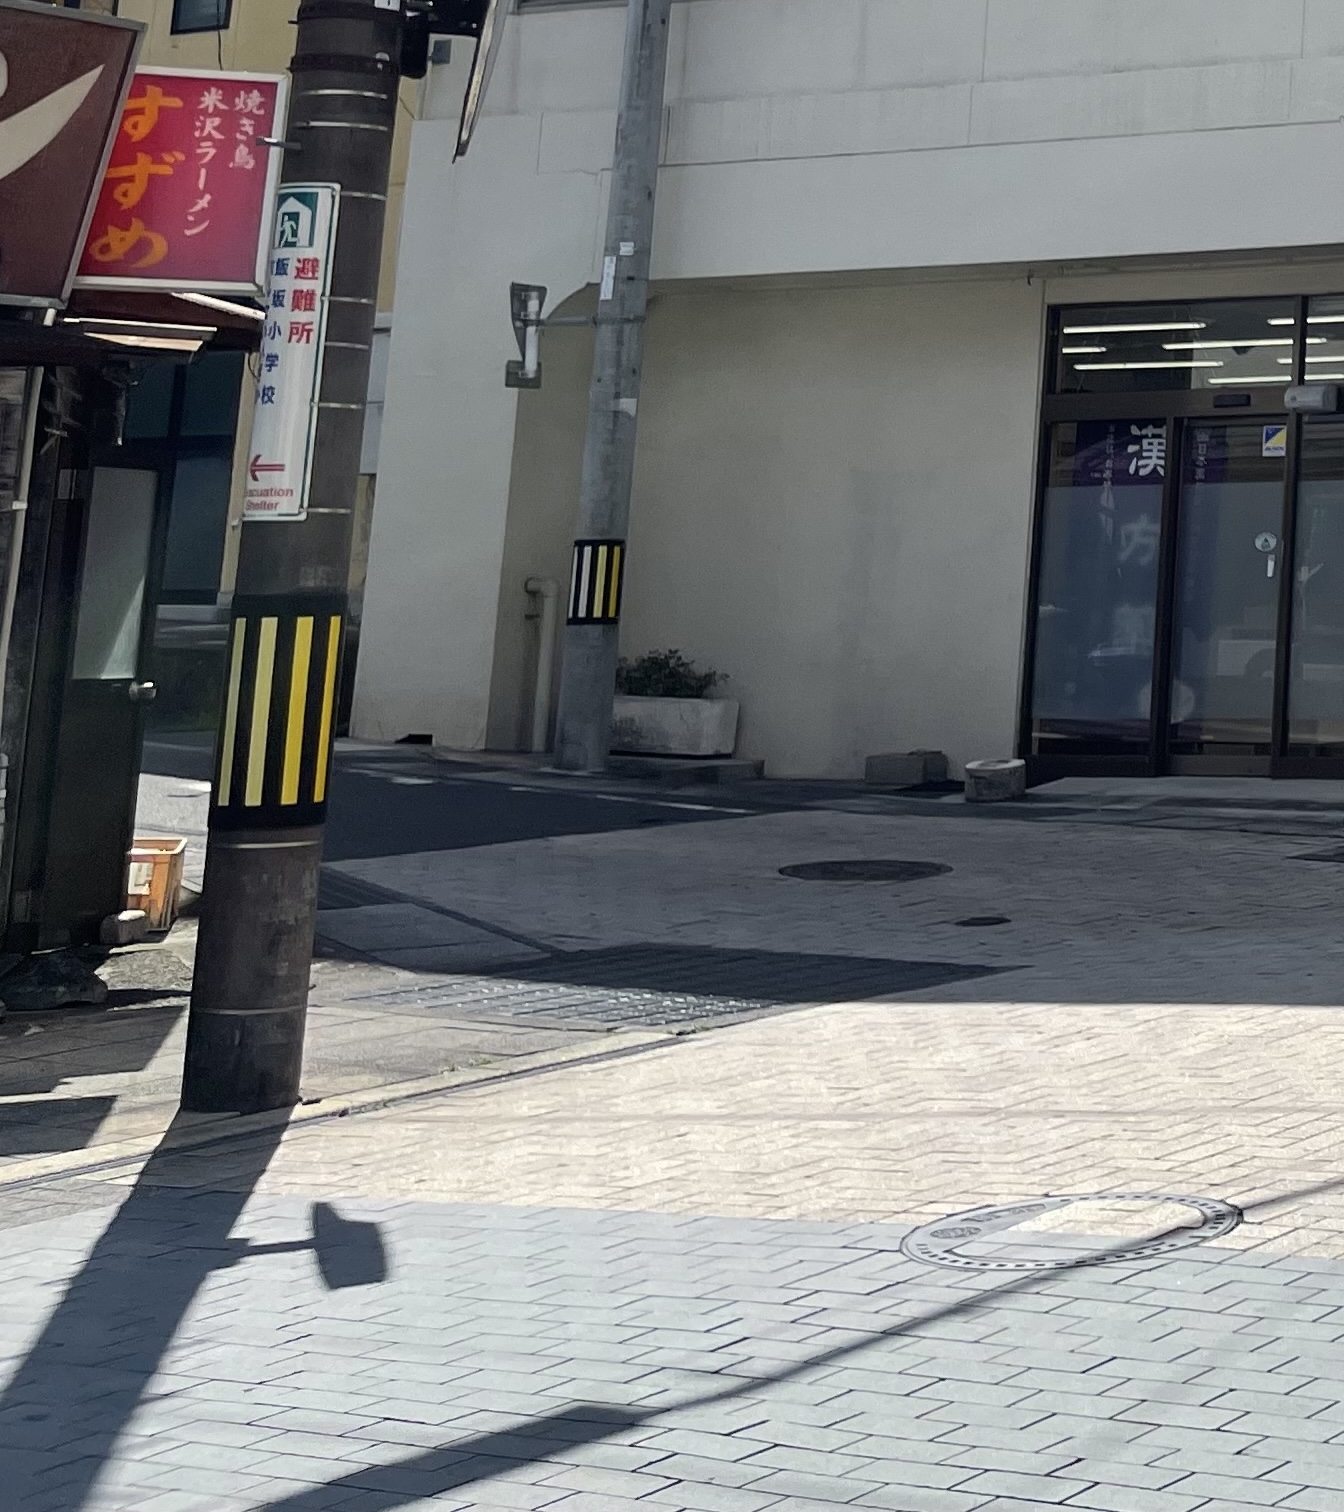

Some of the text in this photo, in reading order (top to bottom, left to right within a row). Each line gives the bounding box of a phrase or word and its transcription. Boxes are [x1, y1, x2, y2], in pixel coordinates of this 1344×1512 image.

[88, 85, 185, 268] すずめ
[184, 87, 229, 236] 米沢ラーメン
[229, 89, 265, 169] 焼き鳥
[288, 257, 320, 345] 避難所
